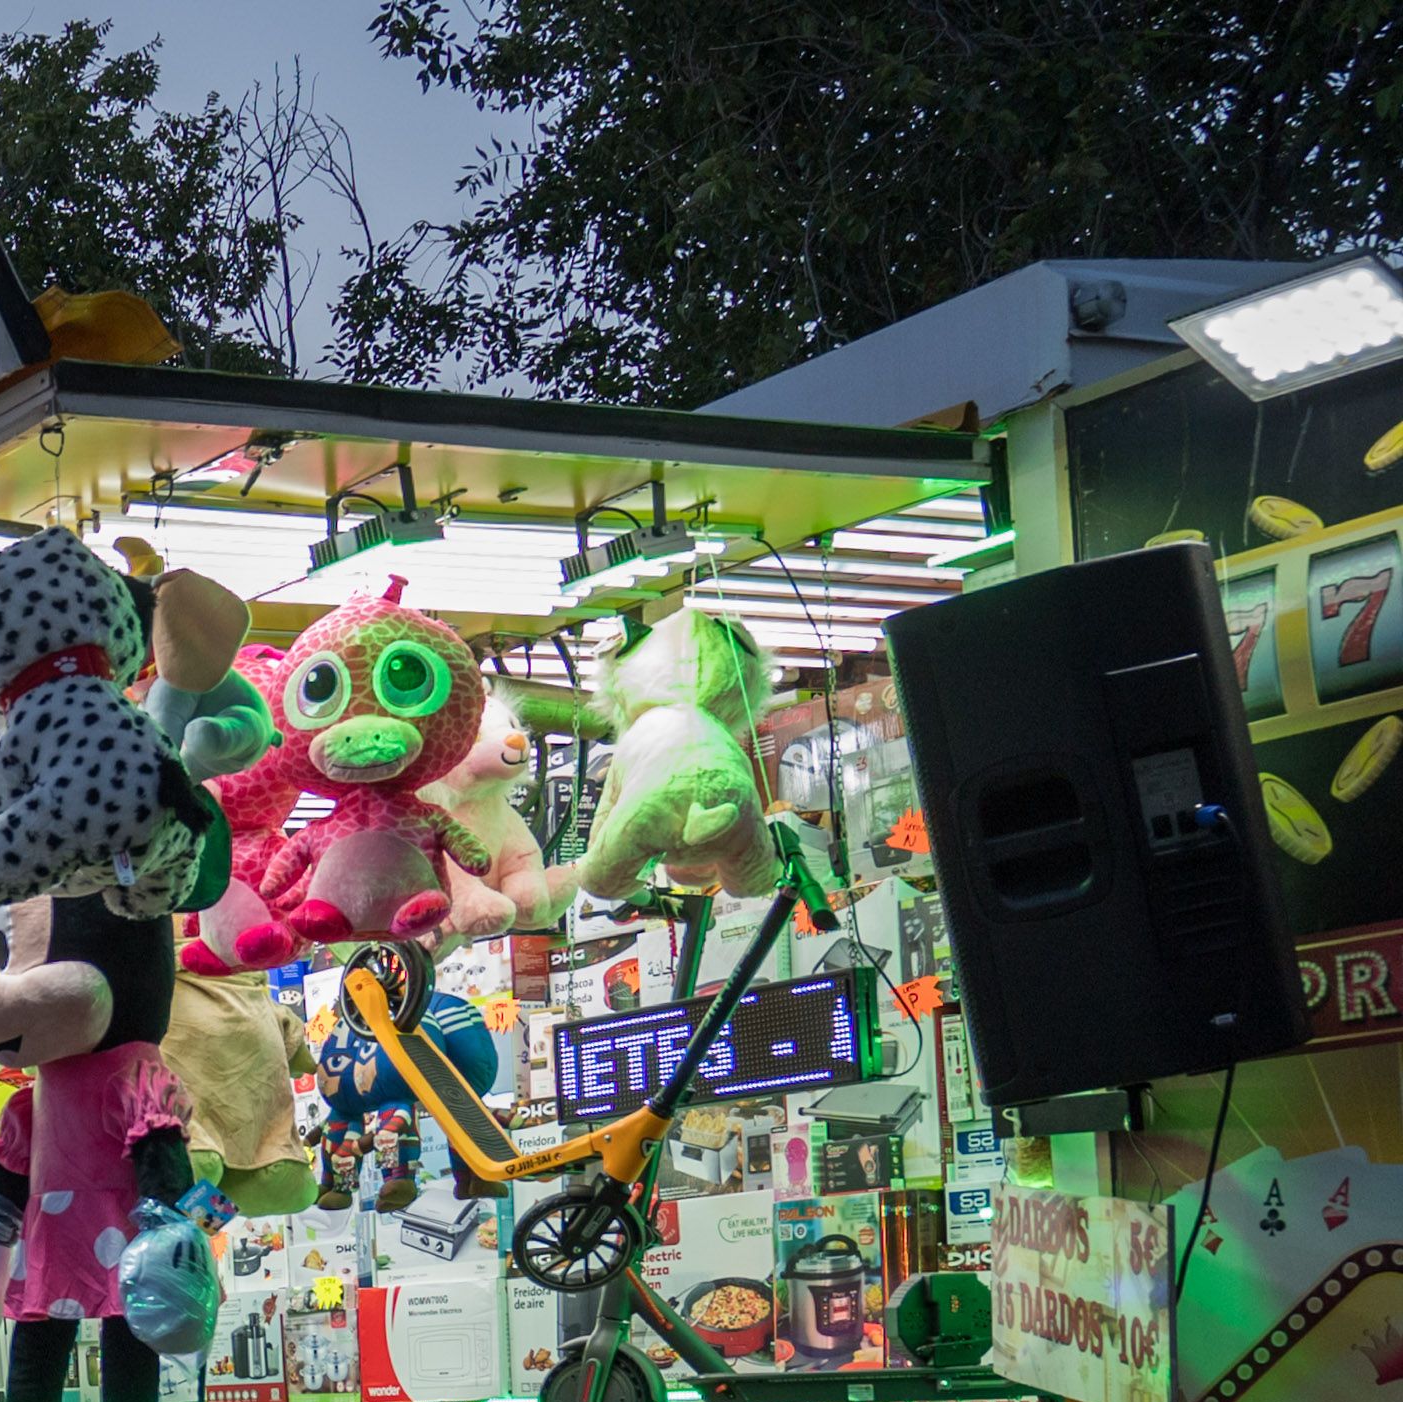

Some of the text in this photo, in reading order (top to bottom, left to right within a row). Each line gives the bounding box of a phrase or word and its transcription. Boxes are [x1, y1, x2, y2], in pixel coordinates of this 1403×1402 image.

[1320, 567, 1393, 668] 7
[550, 949, 586, 965] DHG
[1298, 950, 1403, 1021] PR
[517, 1101, 557, 1120] DHG
[518, 1136, 557, 1148] Freidora
[1263, 1178, 1285, 1206] A
[1328, 1176, 1350, 1206] A
[1008, 1196, 1090, 1264] DARDOS
[1130, 1219, 1159, 1277] 5€
[649, 1281, 662, 1290] an
[514, 1300, 545, 1310] de aire
[996, 1281, 1160, 1371] 15 DARDOS 10€
[368, 1385, 400, 1397] wonder
